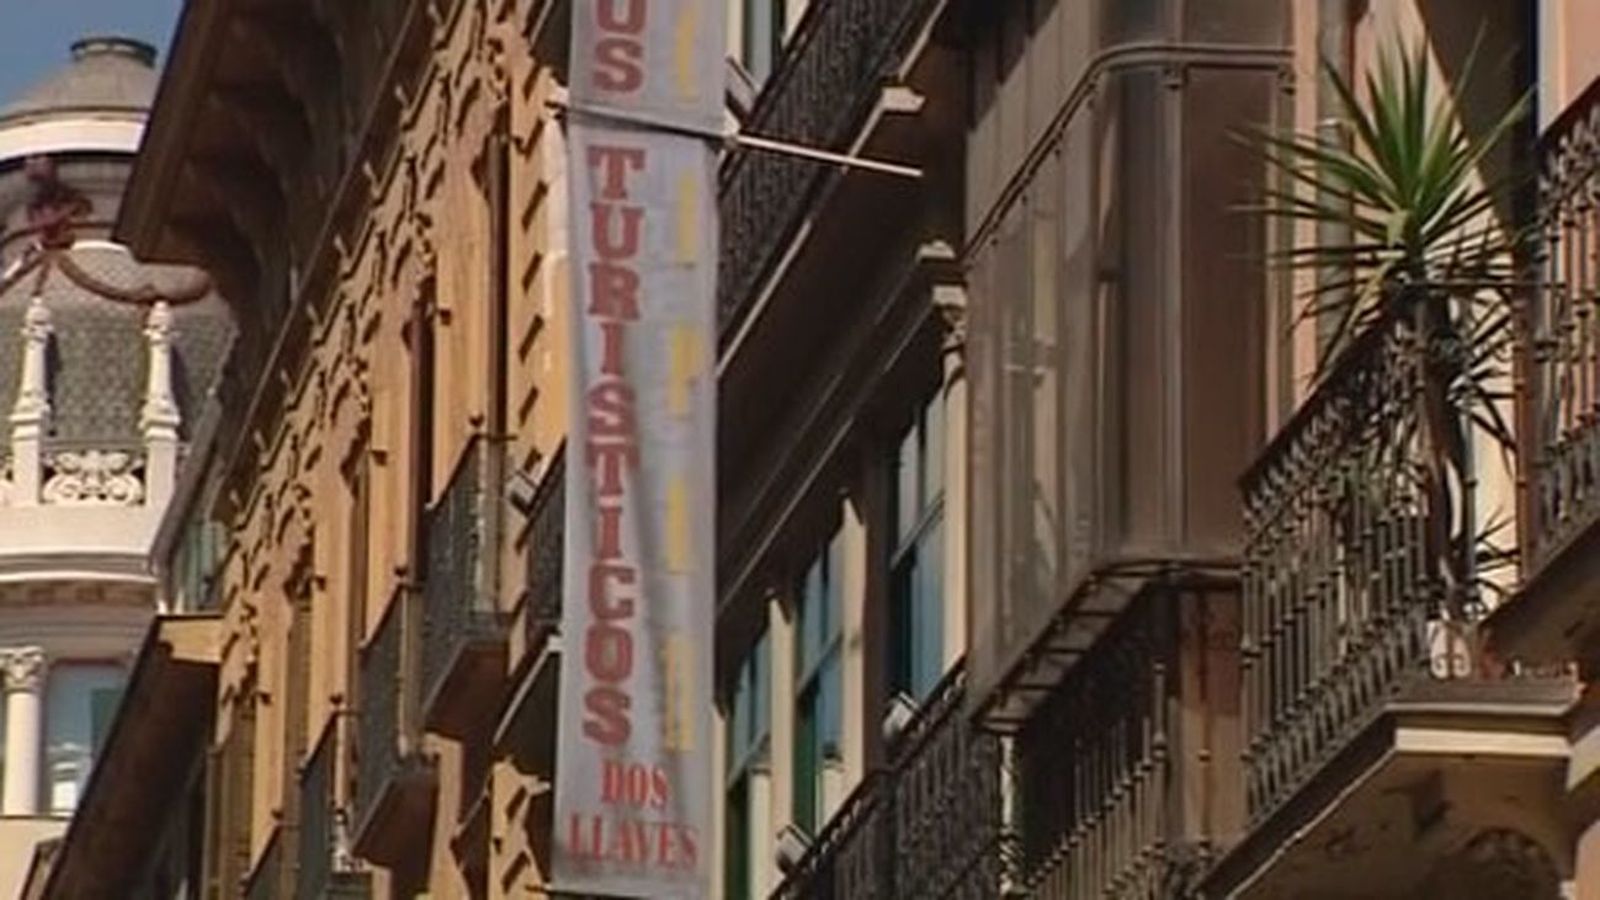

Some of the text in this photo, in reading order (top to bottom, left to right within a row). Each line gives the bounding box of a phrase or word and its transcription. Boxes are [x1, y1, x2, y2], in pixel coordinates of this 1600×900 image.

[583, 146, 646, 747] TURISTICOS
[601, 761, 669, 809] DOS
[567, 812, 699, 869] LLAVES
